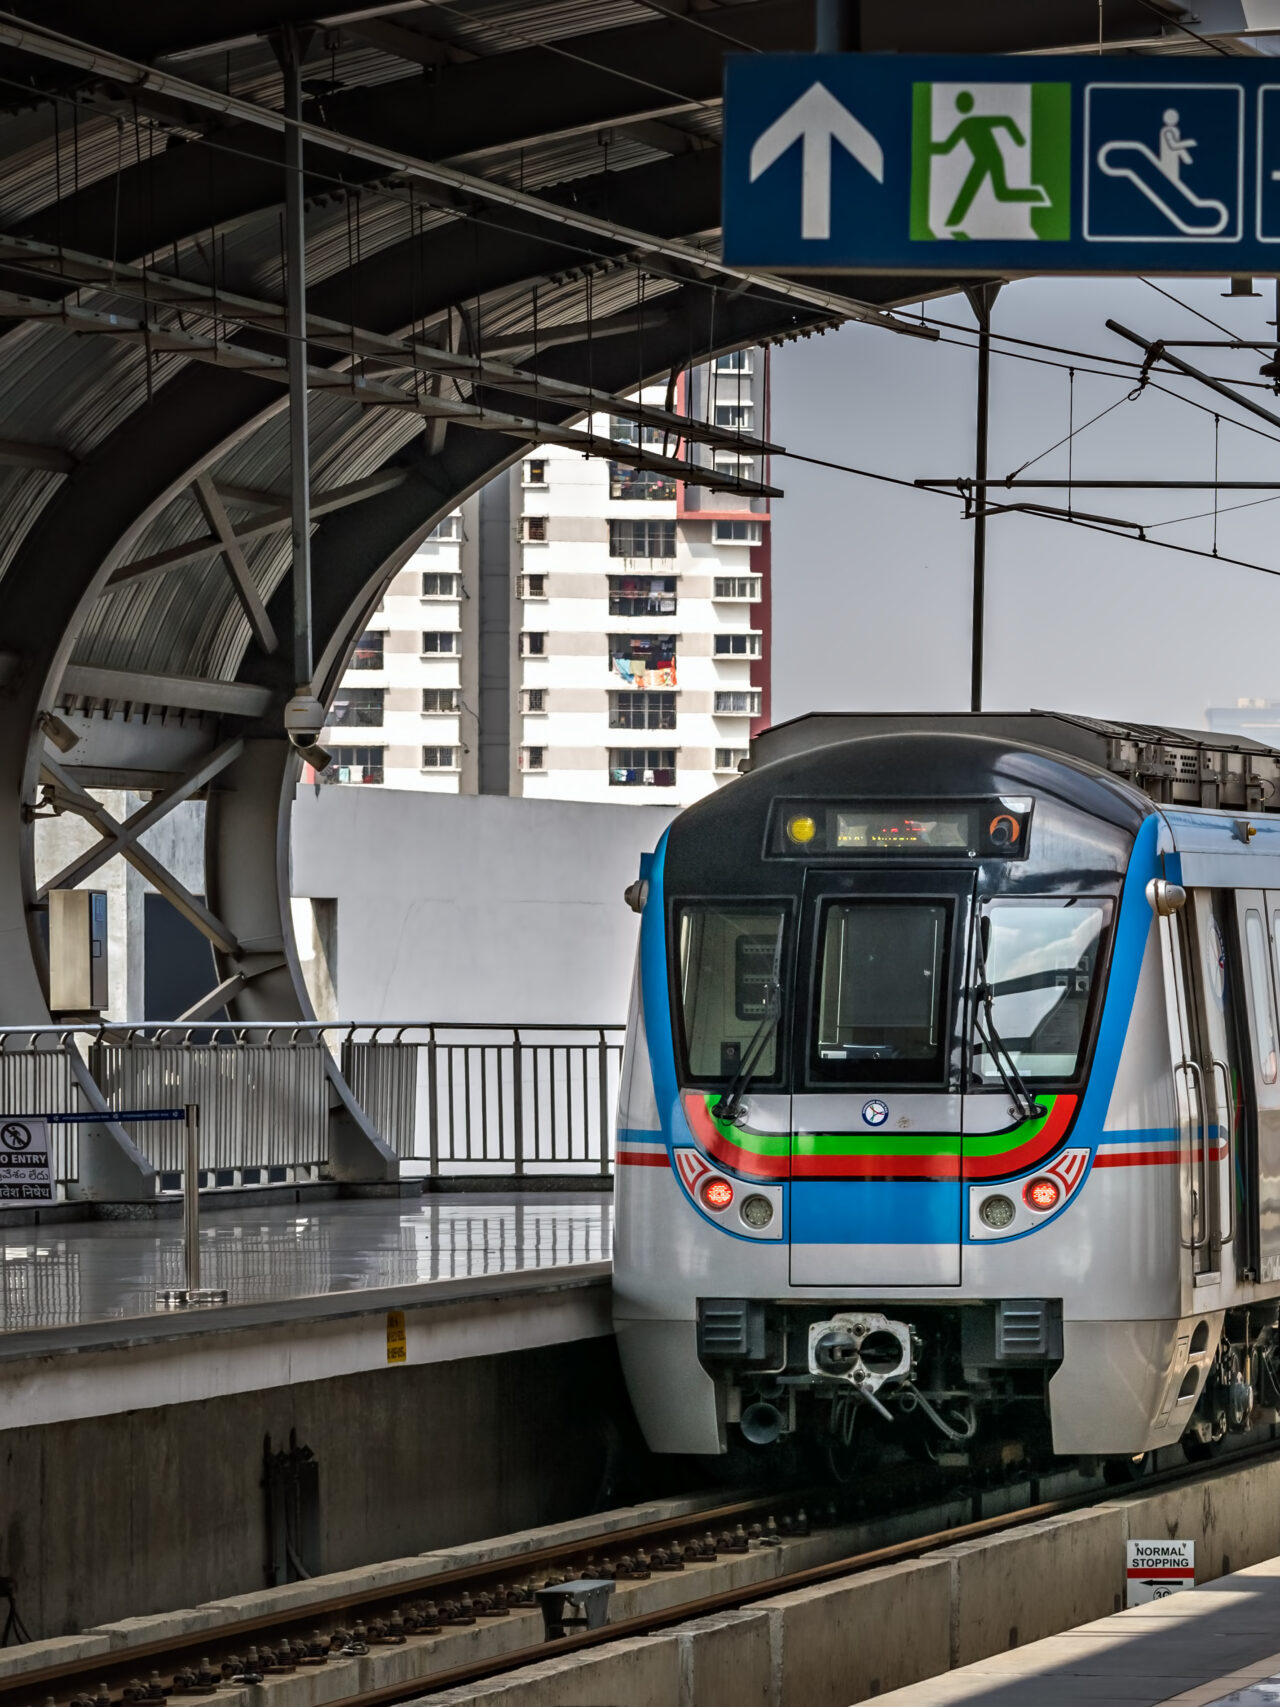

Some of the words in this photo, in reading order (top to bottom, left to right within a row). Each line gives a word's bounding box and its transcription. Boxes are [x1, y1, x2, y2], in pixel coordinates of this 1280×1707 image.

[11, 1154, 46, 1164] ENTRY
[1136, 1547, 1184, 1556] NORMAL
[1132, 1558, 1189, 1567] STOPPING
